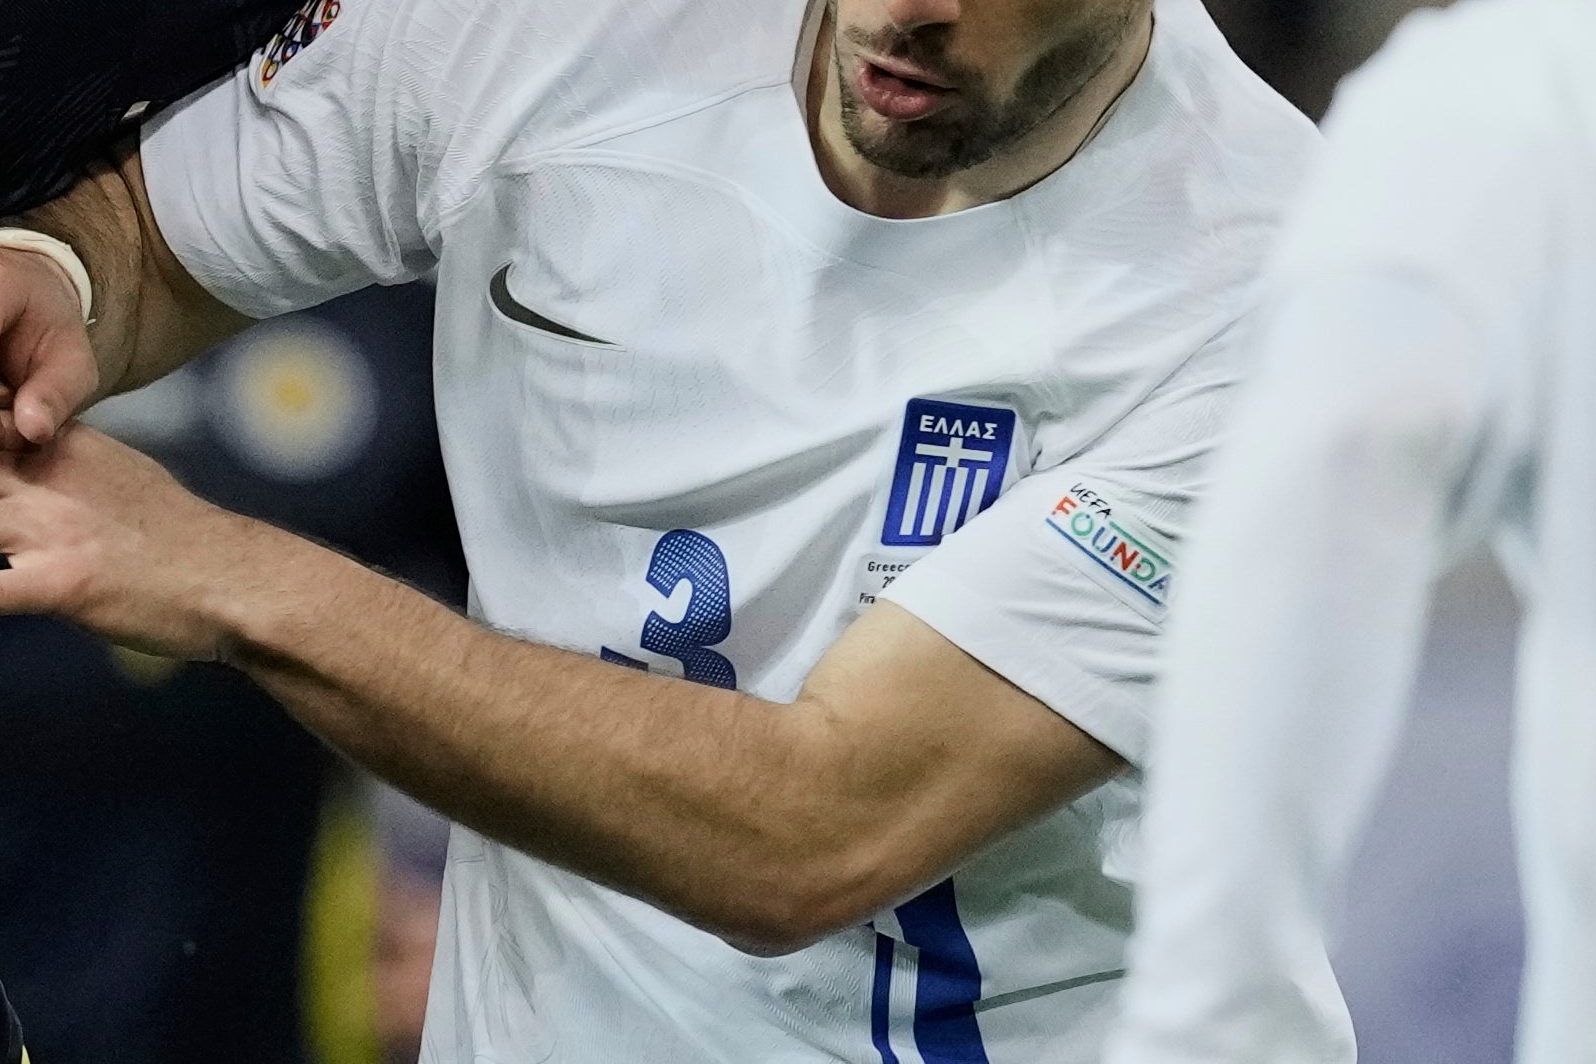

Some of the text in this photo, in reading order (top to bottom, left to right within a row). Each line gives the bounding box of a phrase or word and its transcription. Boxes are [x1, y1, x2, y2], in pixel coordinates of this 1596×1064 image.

[919, 414, 998, 440] ΕΛΛΑΣ
[1070, 482, 1113, 520] UEFA
[600, 528, 737, 691] 3
